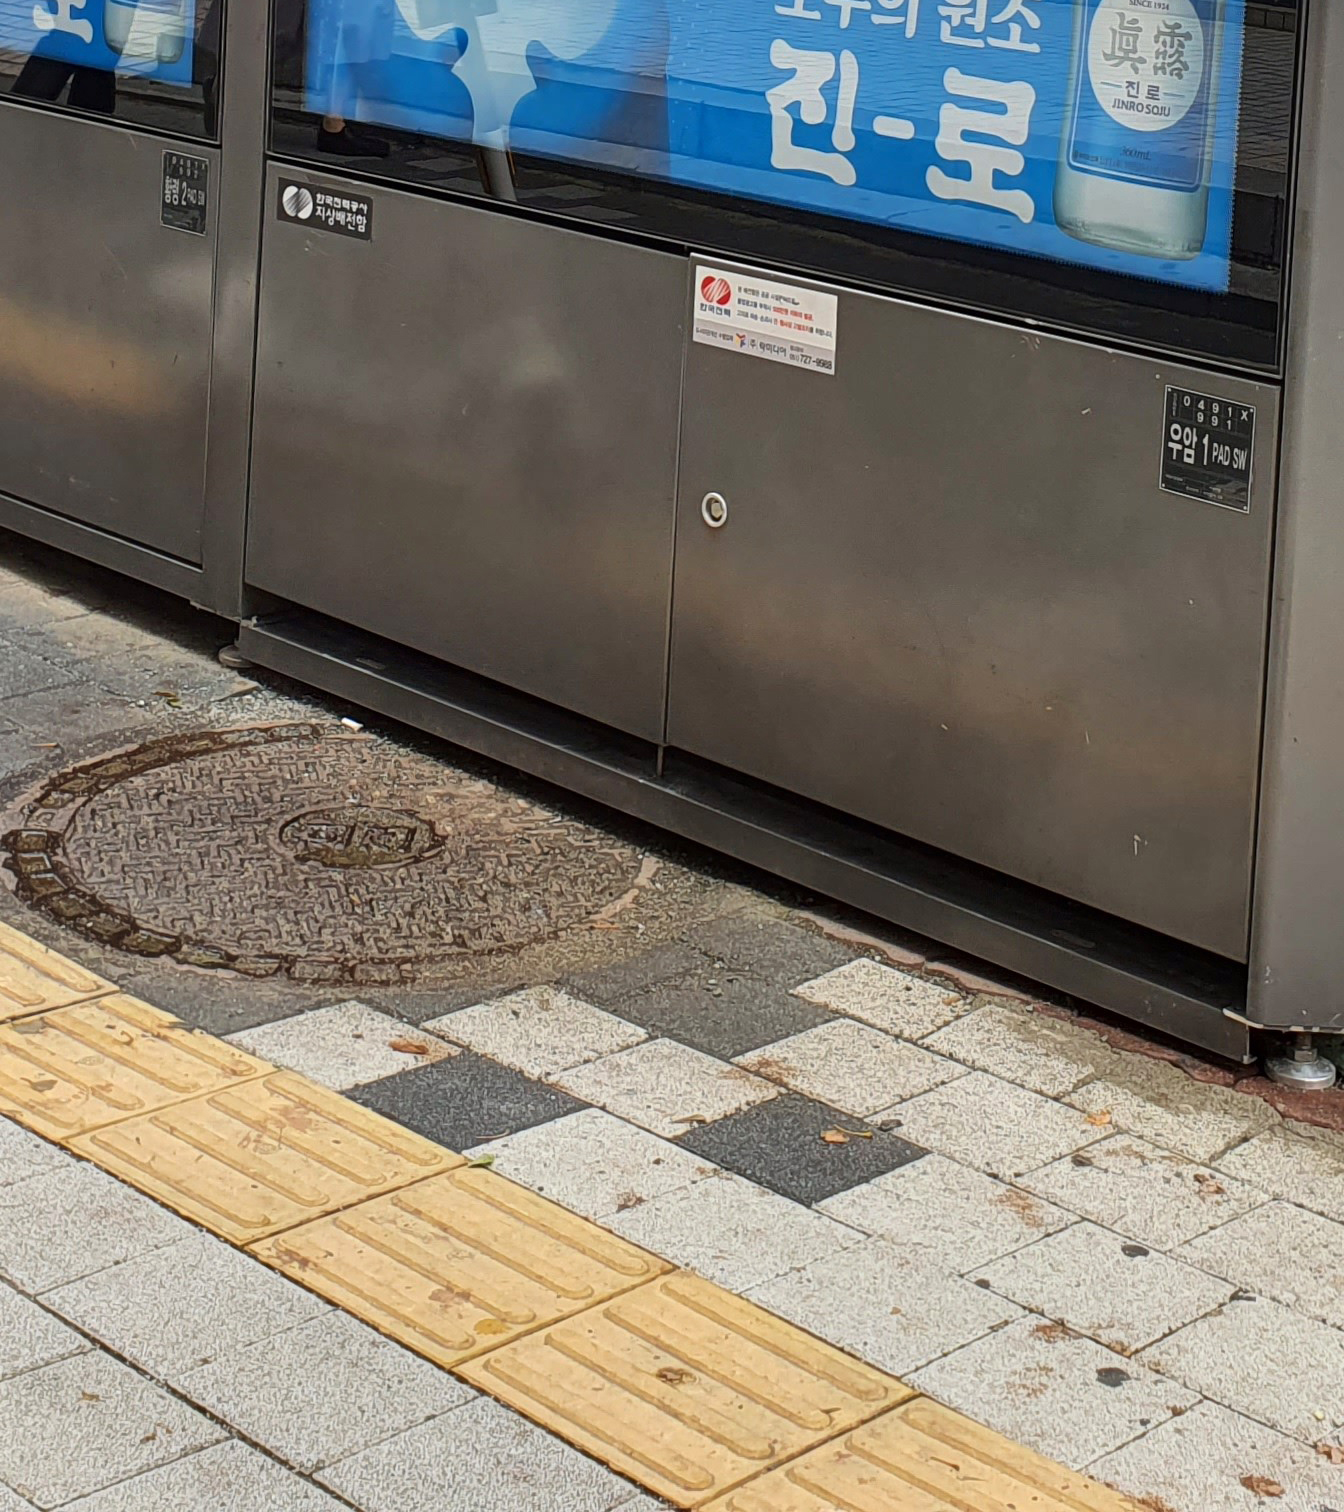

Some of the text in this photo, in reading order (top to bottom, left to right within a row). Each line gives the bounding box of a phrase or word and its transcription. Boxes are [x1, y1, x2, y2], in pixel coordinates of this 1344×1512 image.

[1101, 10, 1193, 81] 眞露
[1125, 79, 1161, 101] 진로
[1112, 97, 1172, 118] JINRO SOJU
[769, 39, 1034, 223] 진-로
[181, 181, 187, 206] 2
[315, 192, 368, 215] 한국전력공사
[315, 205, 368, 233] 지상배전함
[699, 302, 732, 318] 한국전력
[1167, 423, 1197, 465] 우암
[1212, 442, 1230, 465] PAD
[1233, 448, 1248, 470] SW
